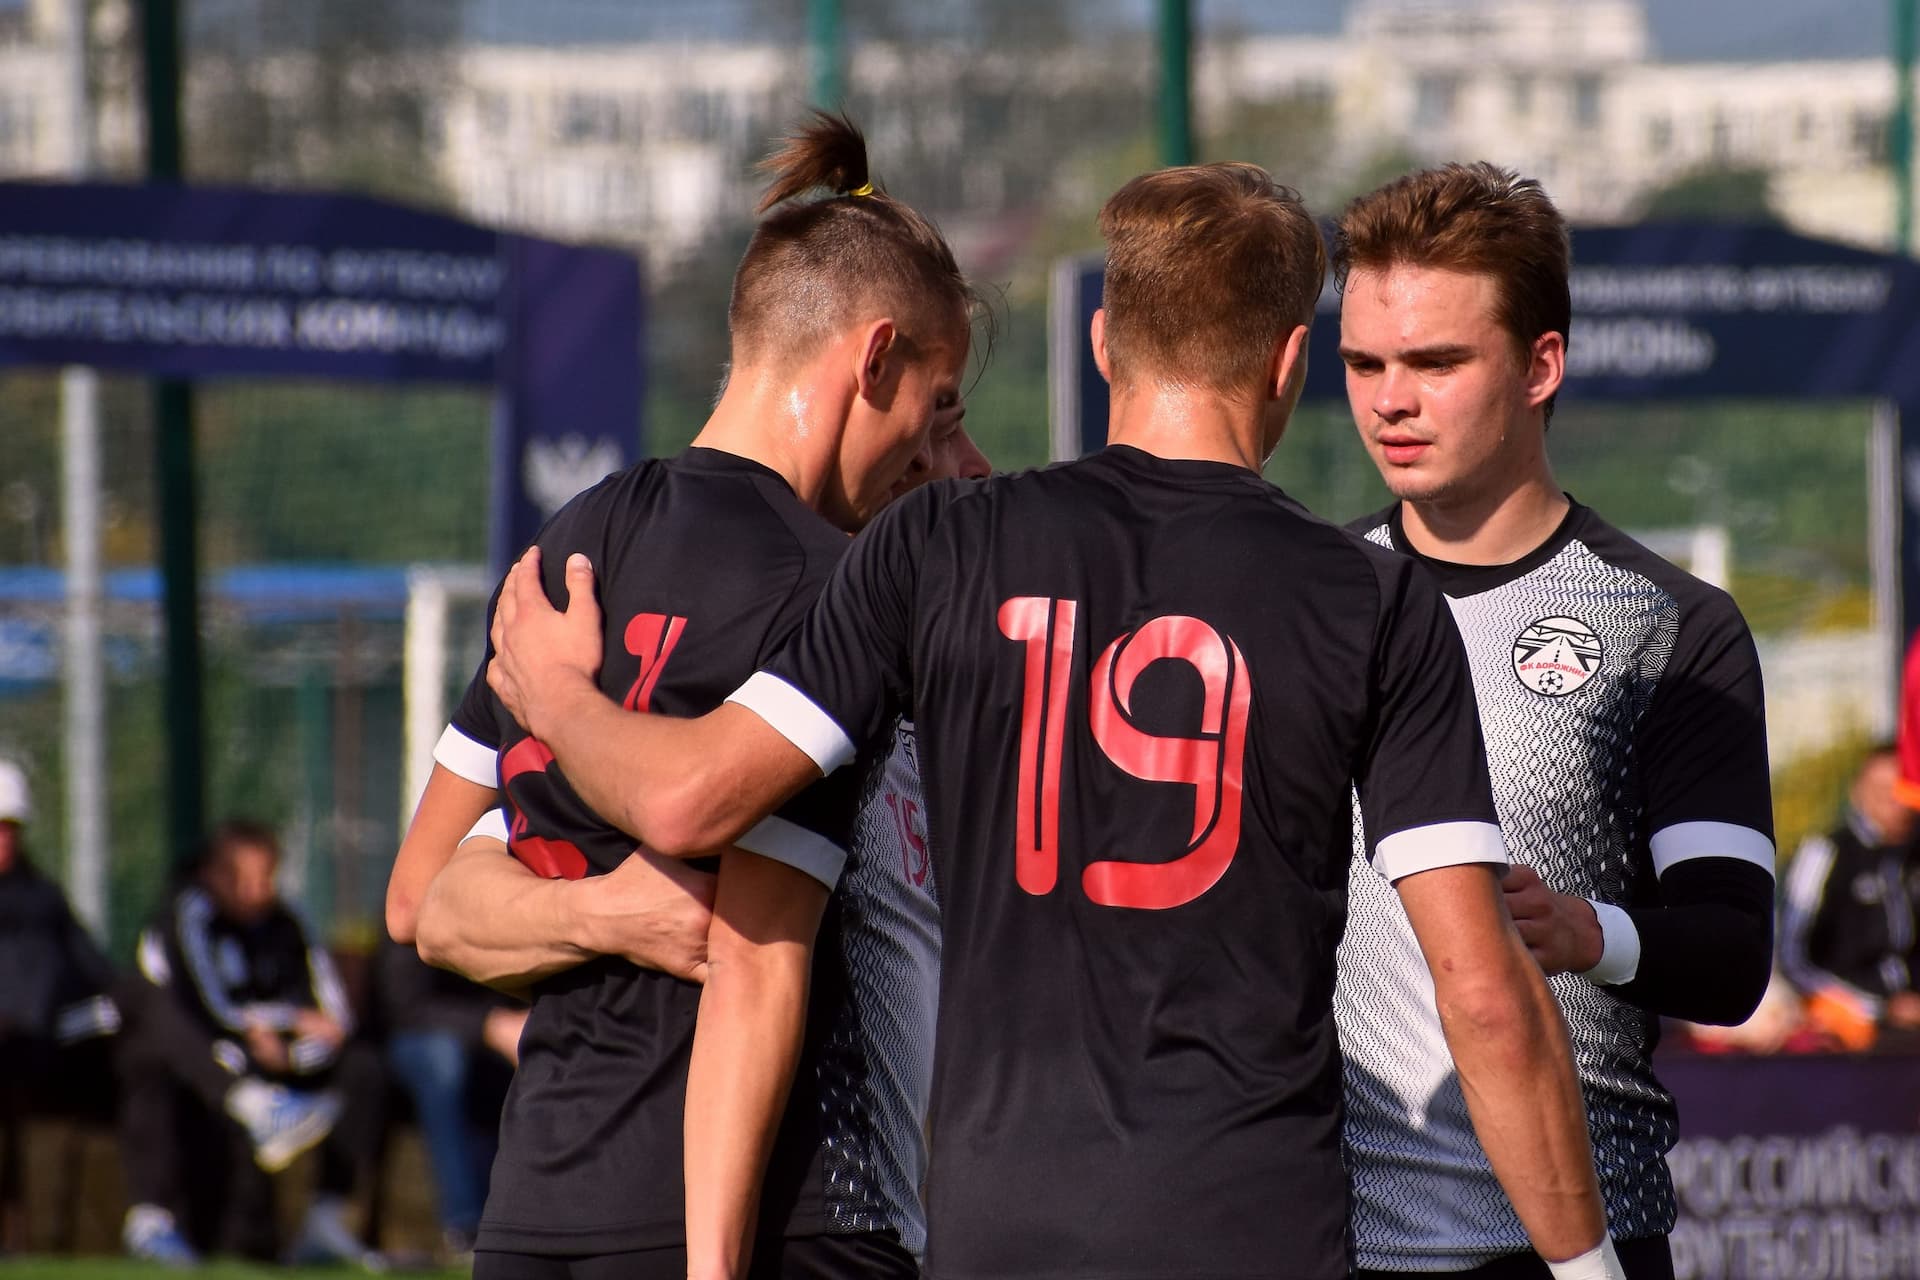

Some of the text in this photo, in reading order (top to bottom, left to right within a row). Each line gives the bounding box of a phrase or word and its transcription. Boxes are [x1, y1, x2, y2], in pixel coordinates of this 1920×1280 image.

[1520, 662, 1586, 678] ФК ДОРОЖНИК
[997, 596, 1251, 911] 19
[884, 792, 929, 888] 15
